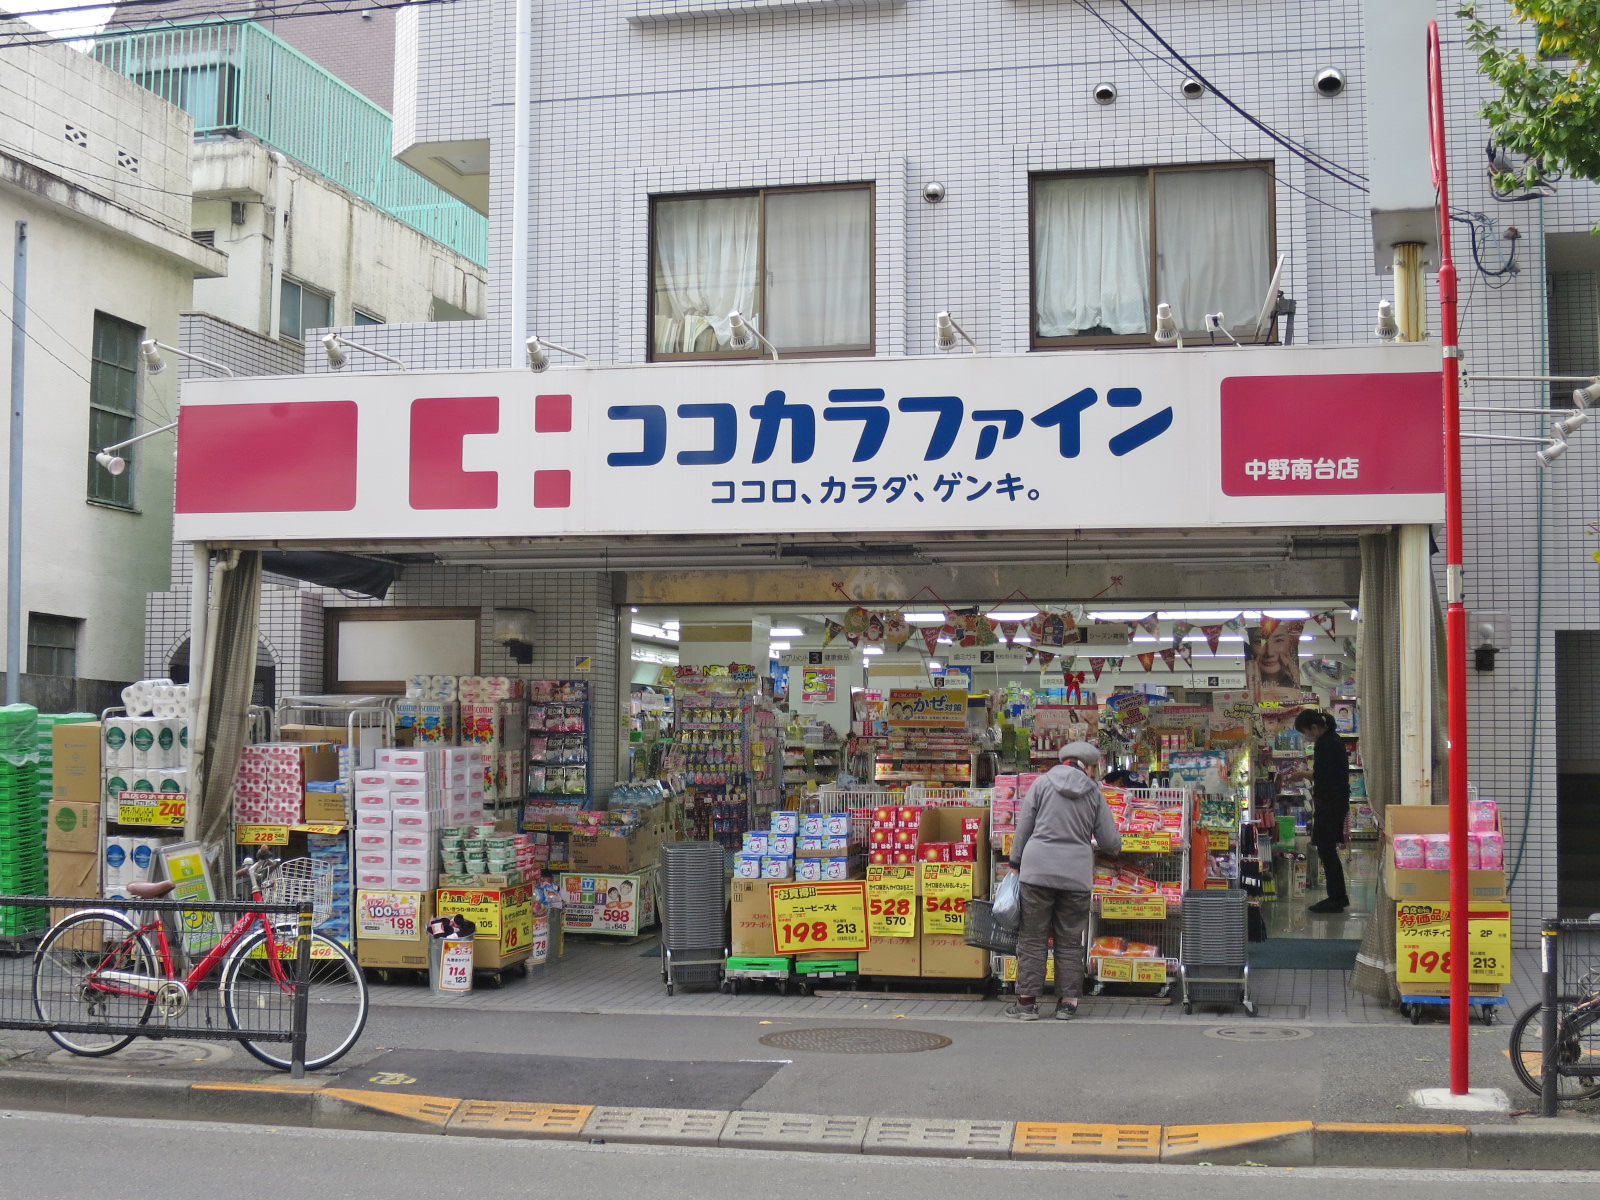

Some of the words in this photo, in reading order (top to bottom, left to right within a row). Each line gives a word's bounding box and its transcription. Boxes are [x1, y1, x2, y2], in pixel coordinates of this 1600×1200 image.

[607, 387, 1174, 468] ココカラファイン
[1245, 456, 1360, 481] 中野南台店
[711, 471, 1040, 504] ココロ、カラダ、ゲンキ。
[781, 653, 809, 662] サプリメント
[811, 652, 820, 664] 3
[823, 653, 850, 661] 健康食品
[983, 652, 992, 663] 2
[935, 678, 943, 687] 6
[1208, 677, 1217, 686] 4
[254, 833, 274, 841] 228
[792, 904, 838, 913] ニュービーズ大
[870, 898, 911, 916] 528
[926, 897, 966, 913] 548
[603, 909, 630, 922] 598
[885, 916, 907, 926] 570
[944, 914, 962, 923] 591
[390, 918, 414, 929] 198
[479, 920, 493, 928] 105
[836, 923, 857, 934] 213
[504, 927, 518, 948] 98
[782, 921, 828, 944] 198
[1403, 929, 1471, 937] ソフィボディフ
[311, 948, 332, 957] 498
[1473, 957, 1497, 969] 213
[448, 967, 466, 976] 114
